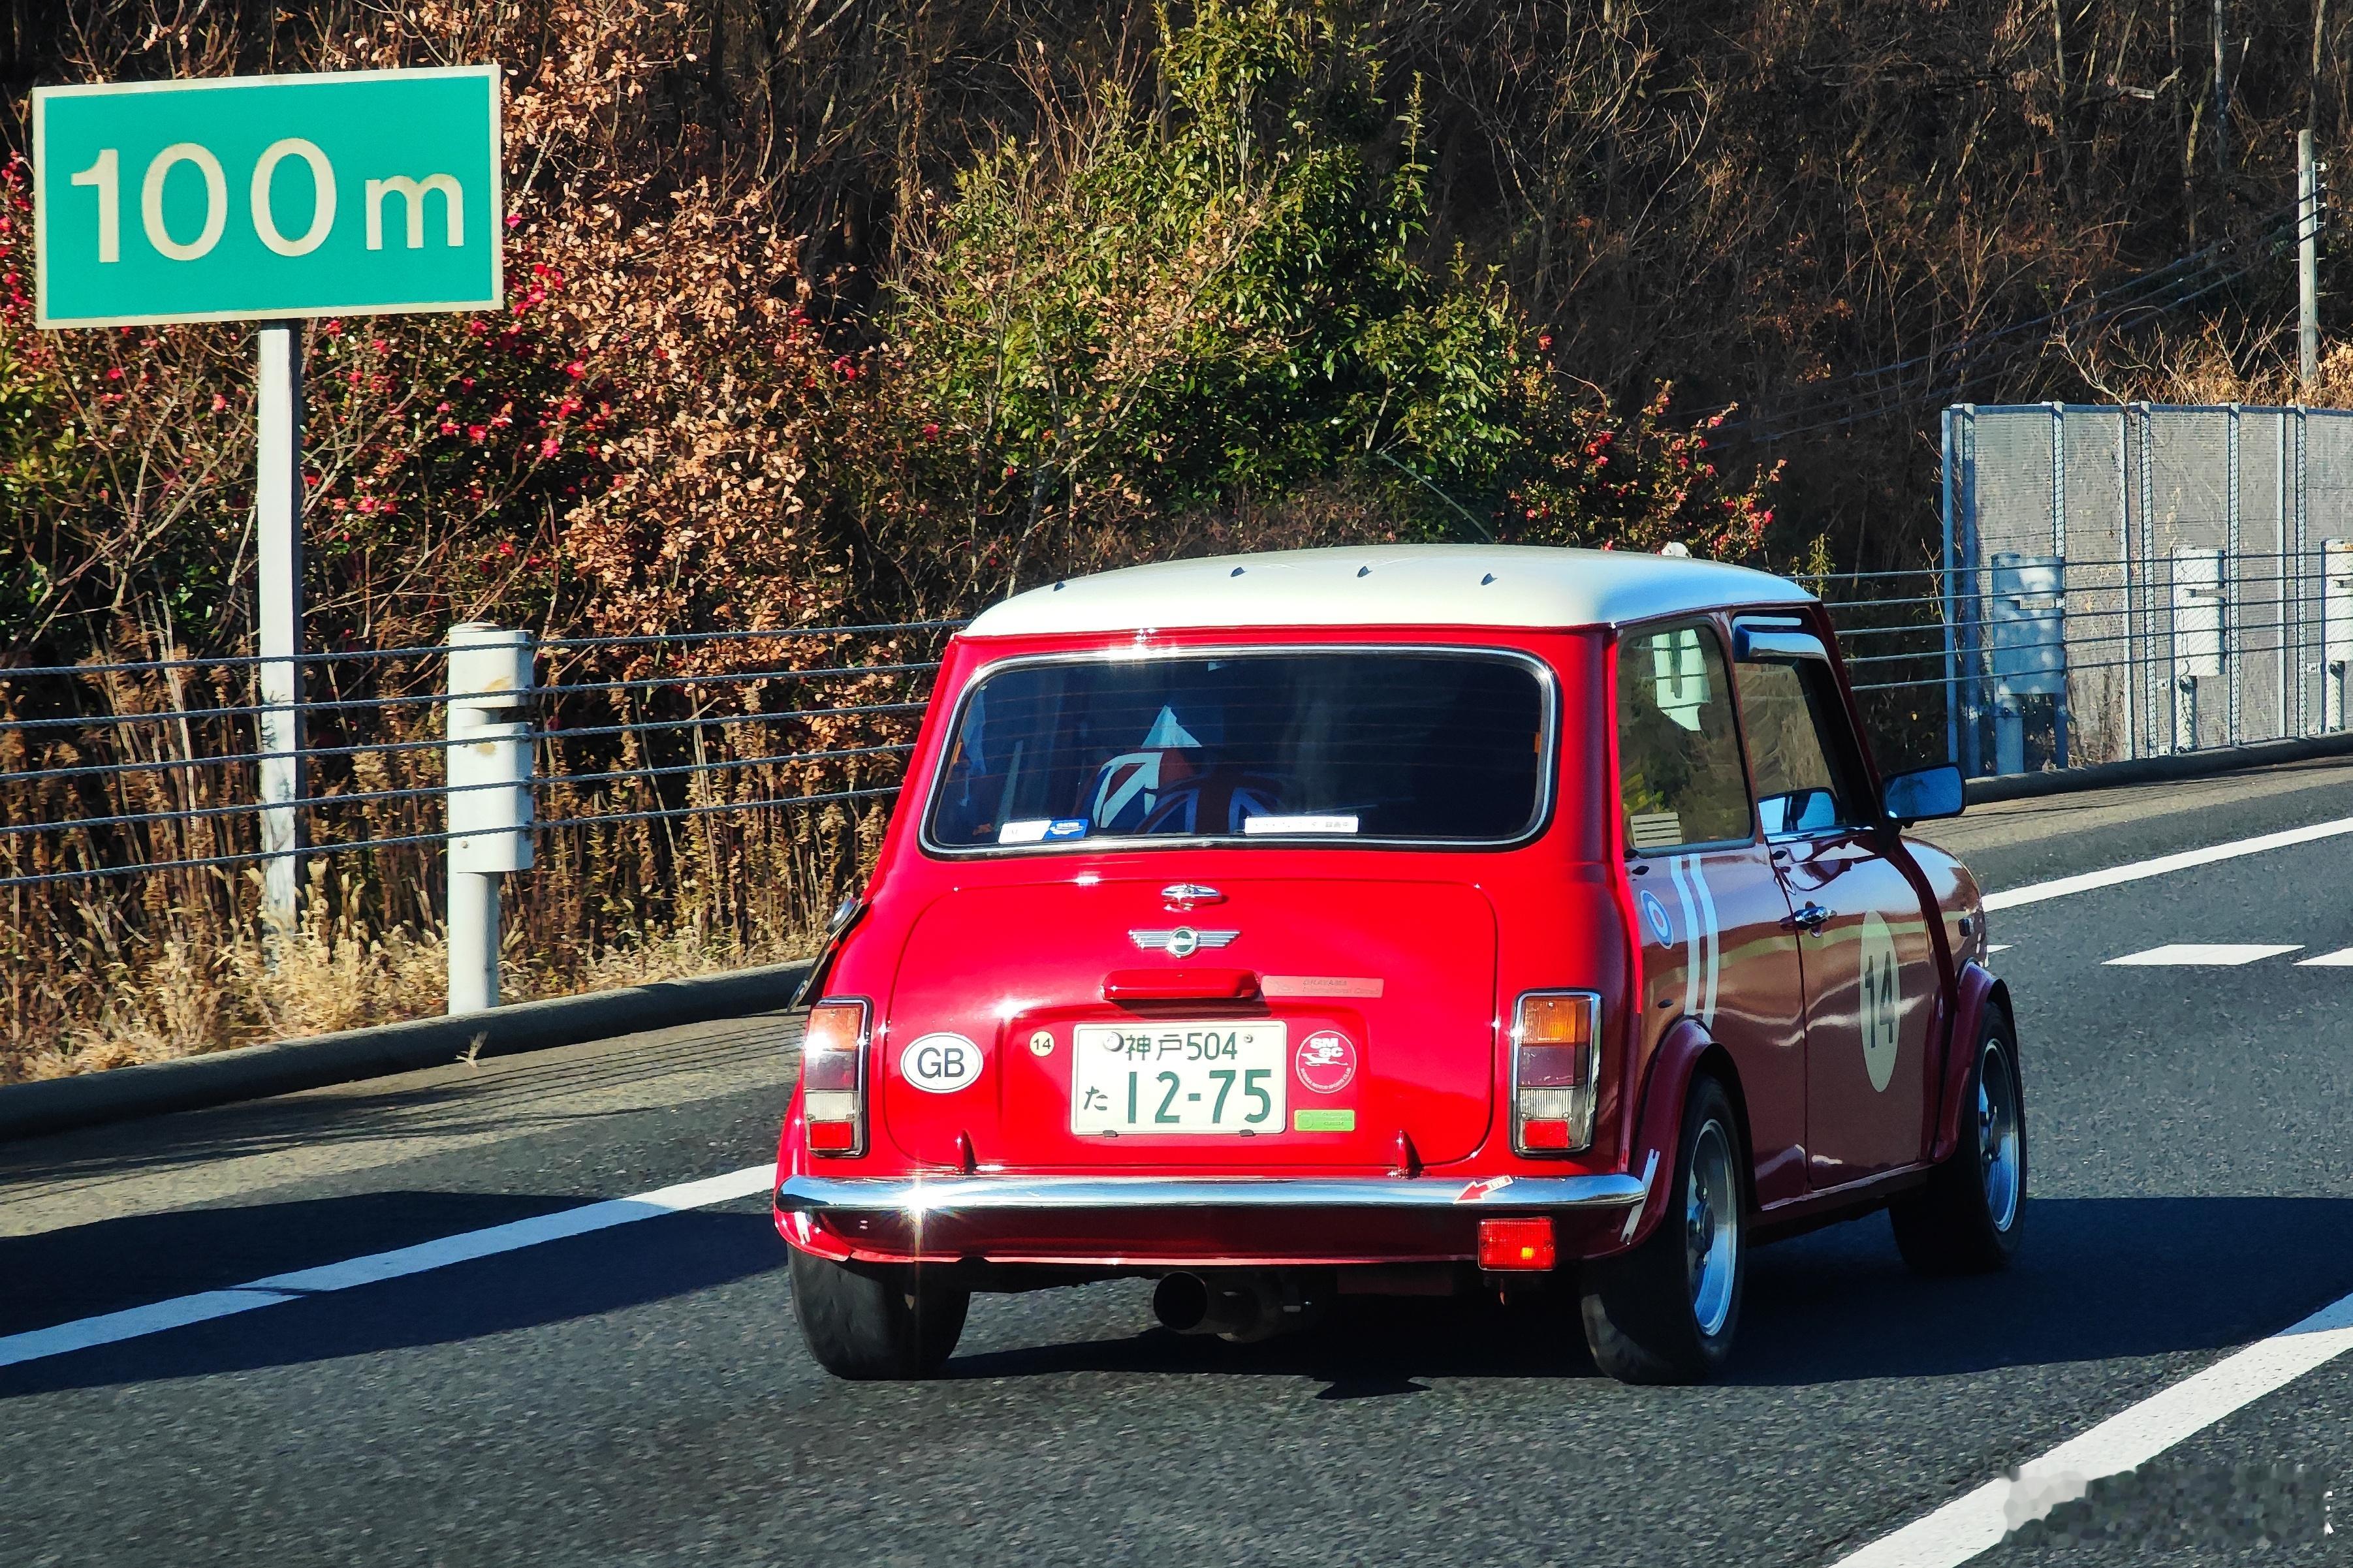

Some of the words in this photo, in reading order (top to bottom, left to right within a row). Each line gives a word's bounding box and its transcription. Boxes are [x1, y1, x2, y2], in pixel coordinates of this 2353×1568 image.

[71, 137, 337, 263] 100
[365, 172, 466, 251] m
[1865, 950, 1895, 1048] 14
[1034, 1038, 1051, 1050] 14
[1310, 1038, 1339, 1048] SM
[1319, 1047, 1344, 1058] SC
[917, 1047, 965, 1078] GB
[1084, 1086, 1109, 1110] た
[1128, 1069, 1272, 1124] 12-75
